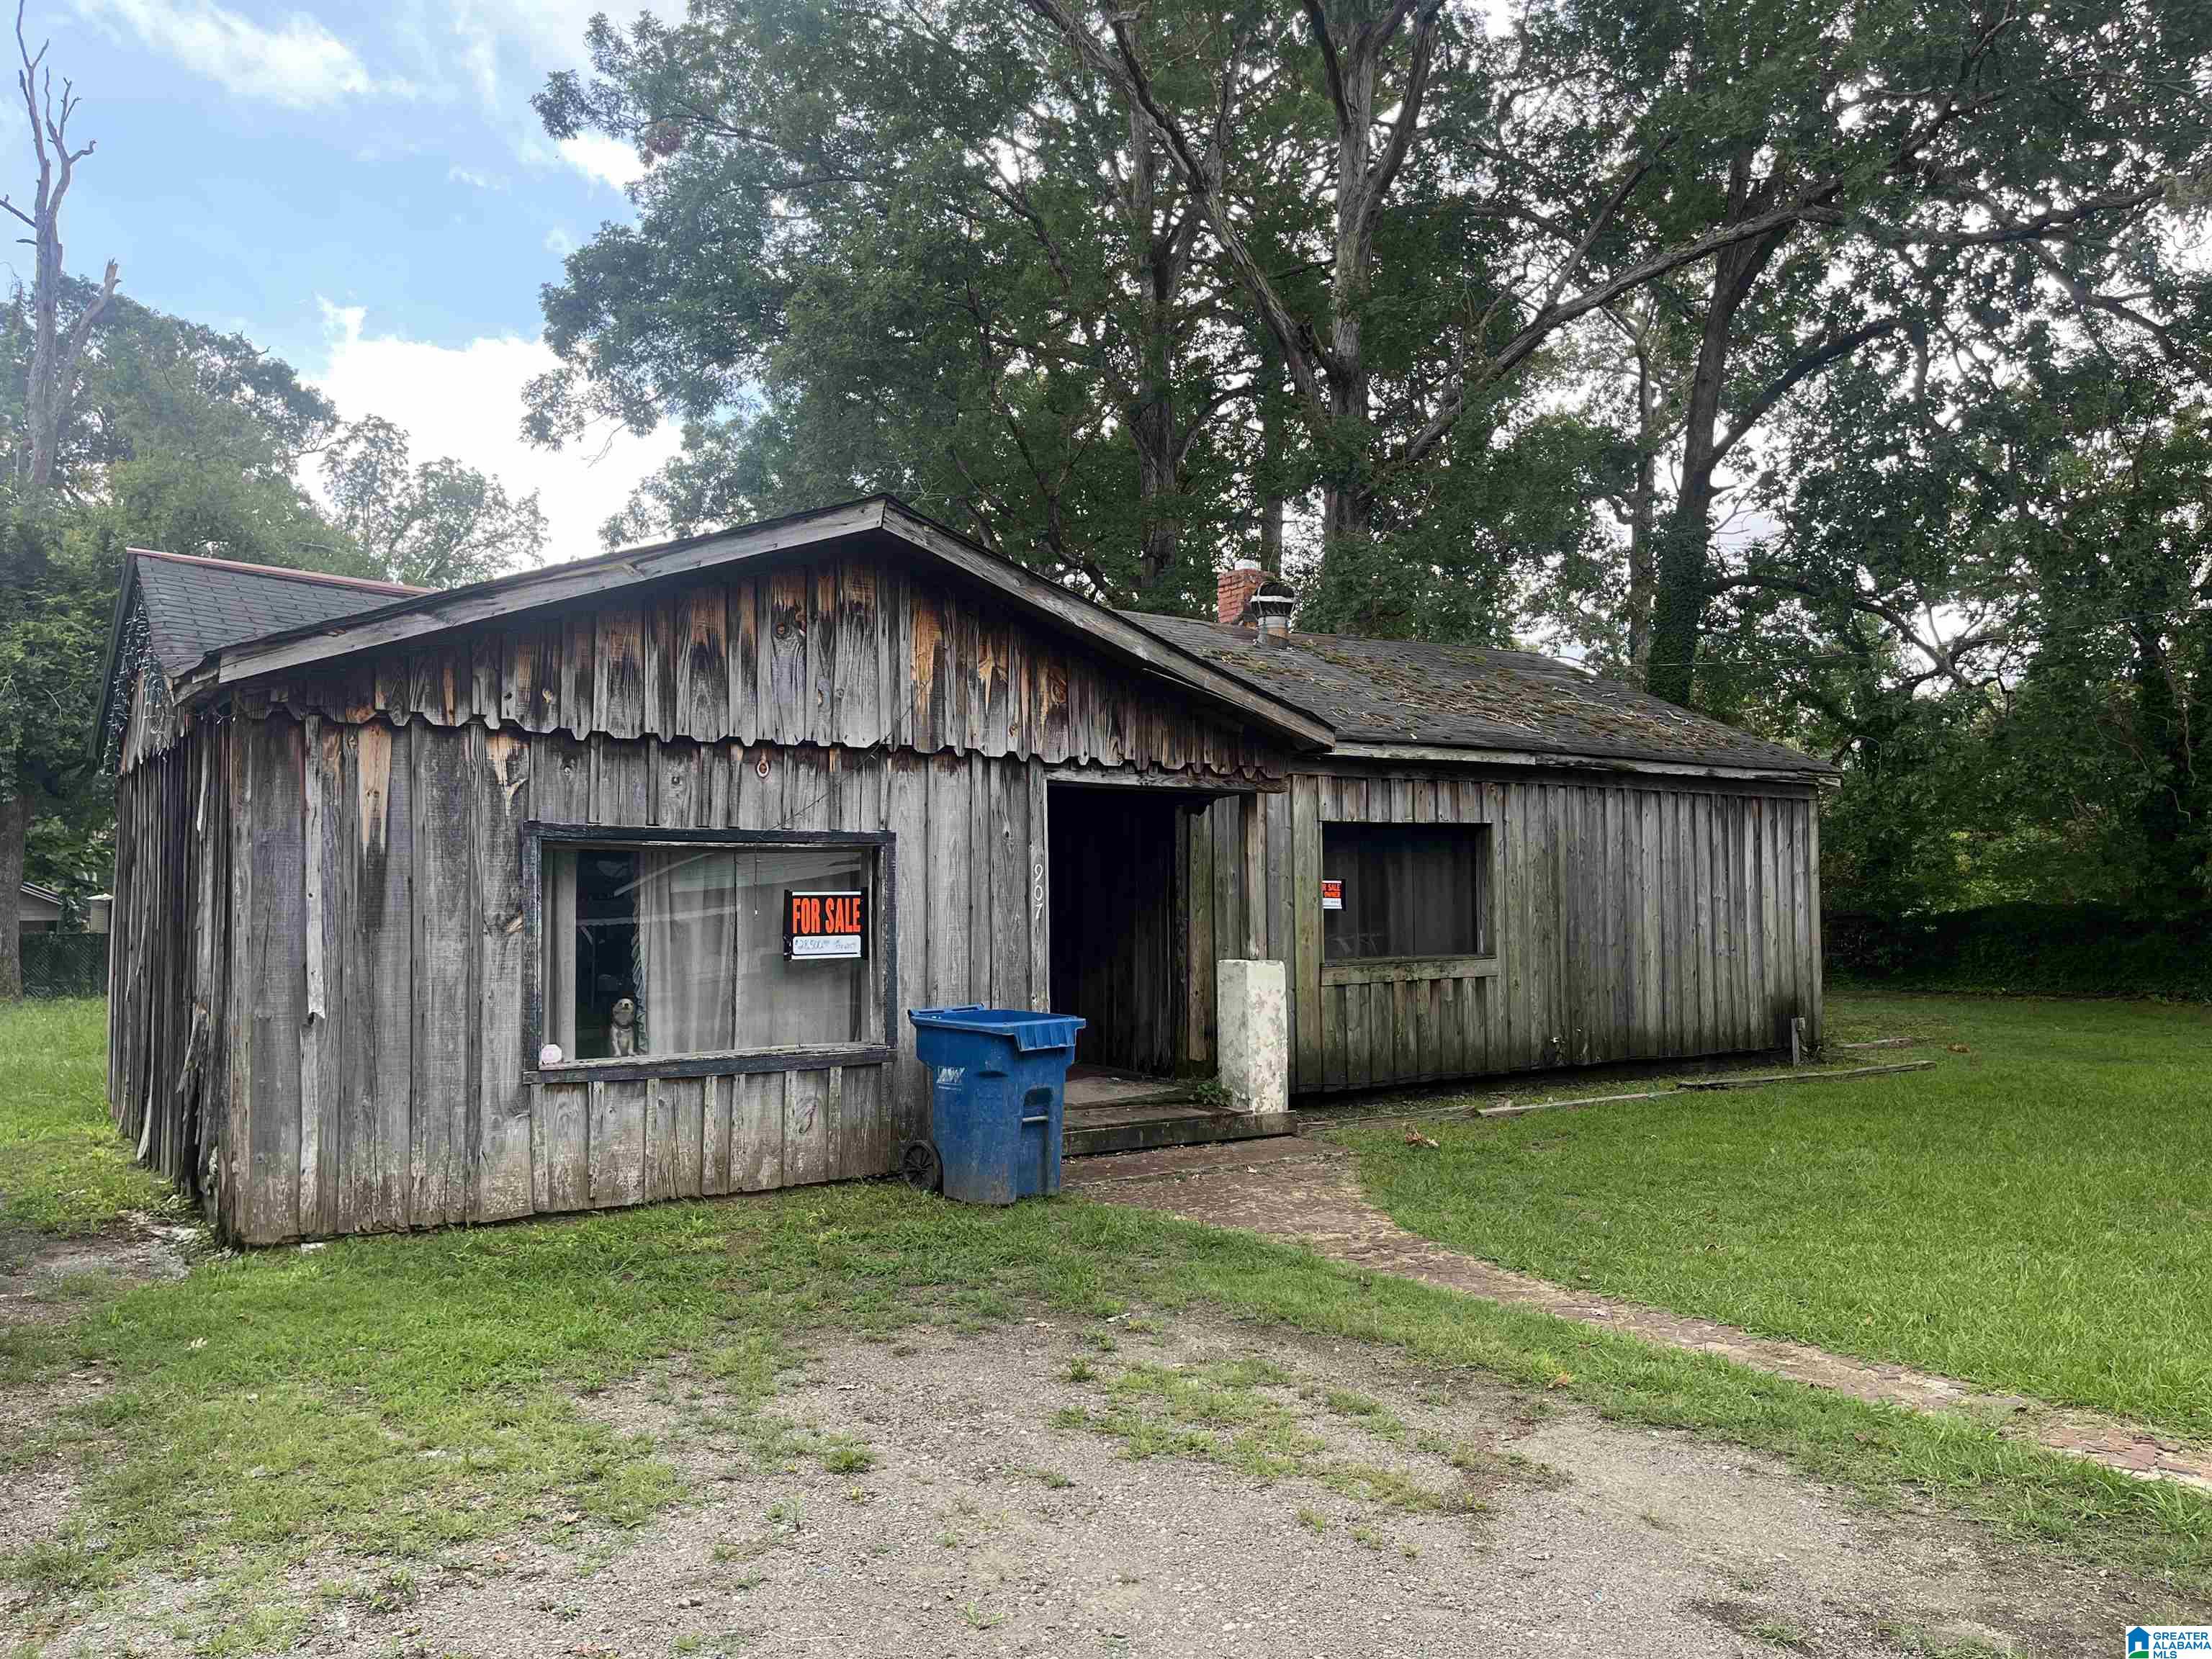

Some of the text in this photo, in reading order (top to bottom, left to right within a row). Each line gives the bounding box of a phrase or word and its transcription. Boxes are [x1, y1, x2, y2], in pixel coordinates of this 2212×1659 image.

[1034, 863, 1043, 920] 907
[792, 897, 862, 934] FOR SALE
